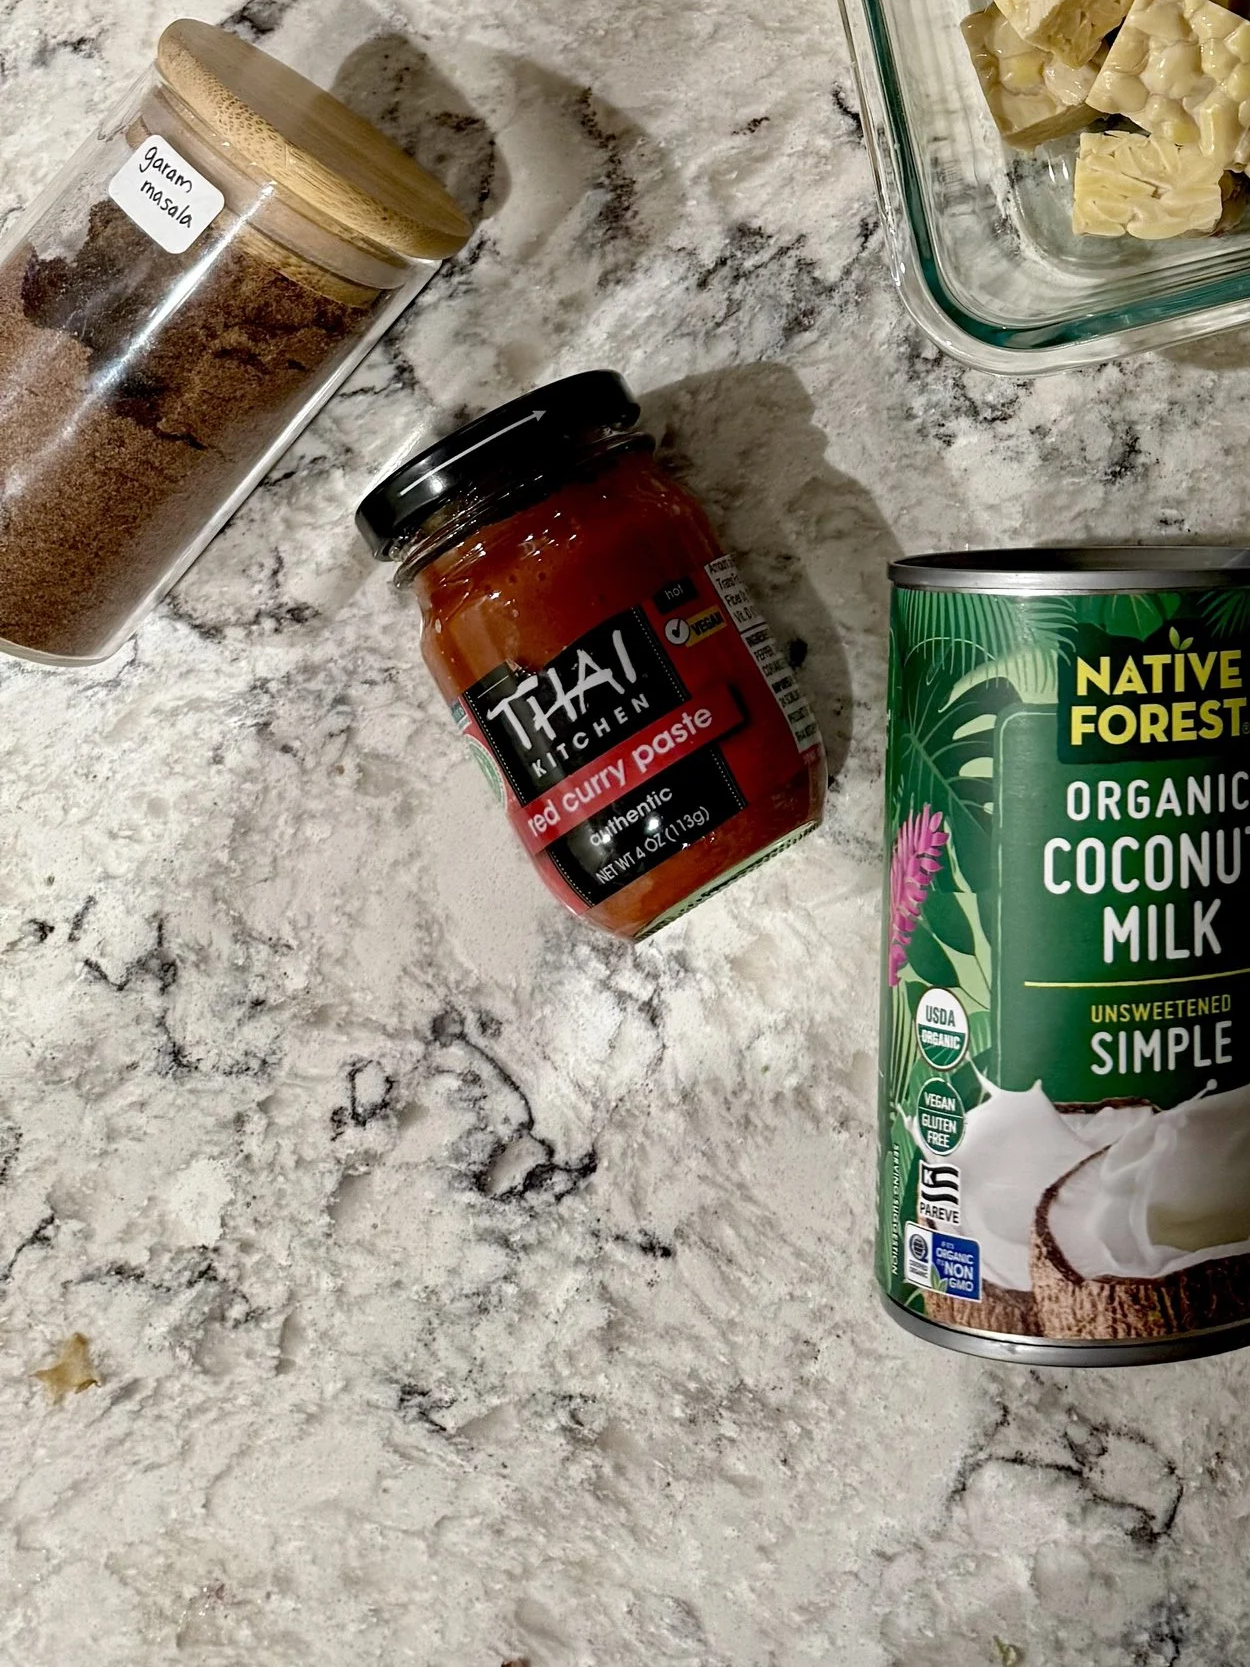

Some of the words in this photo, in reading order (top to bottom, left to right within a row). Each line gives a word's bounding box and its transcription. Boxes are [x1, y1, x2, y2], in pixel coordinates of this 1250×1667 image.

[139, 146, 193, 193] garam
[140, 180, 193, 229] masala
[664, 584, 684, 600] hot
[690, 611, 725, 636] VEGAN
[486, 629, 637, 750] THAI
[1075, 648, 1243, 697] NATIVE
[531, 693, 650, 778] KITCHEN
[1069, 696, 1247, 746] FOREST
[527, 799, 561, 837] red
[561, 758, 627, 813] curry
[631, 708, 712, 774] paste
[1065, 770, 1250, 822] ORGANIC
[589, 787, 673, 847] authentic
[595, 862, 619, 885] NET
[616, 852, 636, 870] WT
[635, 847, 647, 860] 4
[644, 832, 667, 853] OZ
[664, 806, 710, 842] (113g)
[1102, 898, 1222, 964] MILK
[925, 1004, 956, 1027] USDA
[1090, 994, 1232, 1024] UNSWEETENED
[921, 1028, 961, 1050] ORGANIC
[1089, 1020, 1233, 1076] SIMPLE
[924, 1091, 956, 1112] VEGAN
[921, 1113, 957, 1134] GLUTEN
[926, 1131, 951, 1149] FREE
[892, 1142, 900, 1195] SERVING
[922, 1168, 935, 1186] K
[919, 1201, 960, 1224] PAREVE
[935, 1247, 975, 1265] ORGANIC
[944, 1262, 974, 1280] NON
[949, 1277, 974, 1292] GMO
